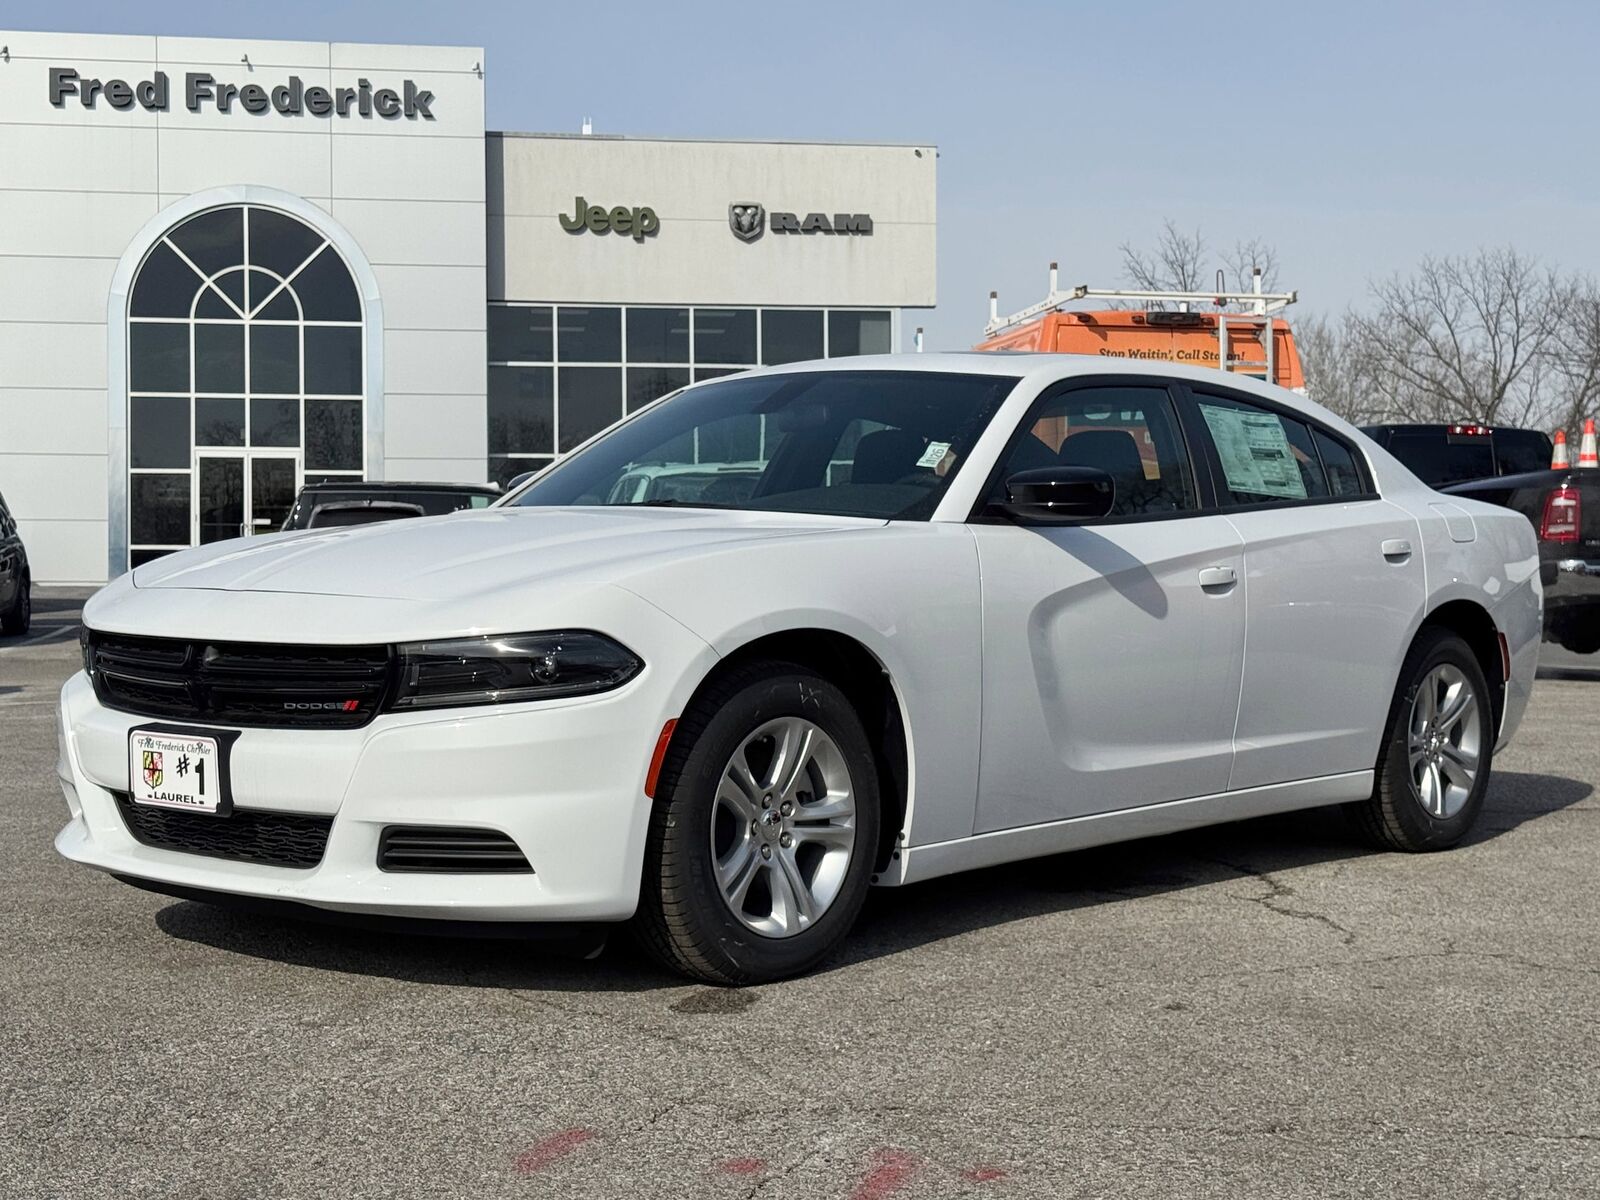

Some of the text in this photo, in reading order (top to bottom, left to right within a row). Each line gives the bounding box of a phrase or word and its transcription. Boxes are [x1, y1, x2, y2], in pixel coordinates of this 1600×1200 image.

[48, 67, 435, 120] Fred Frederick
[558, 196, 660, 243] Jeep
[770, 212, 873, 235] RAM
[1176, 349, 1201, 360] Call
[283, 702, 344, 710] DODGE
[138, 738, 211, 755] Fred Frederick Chrysler
[154, 791, 197, 804] LAUREL
